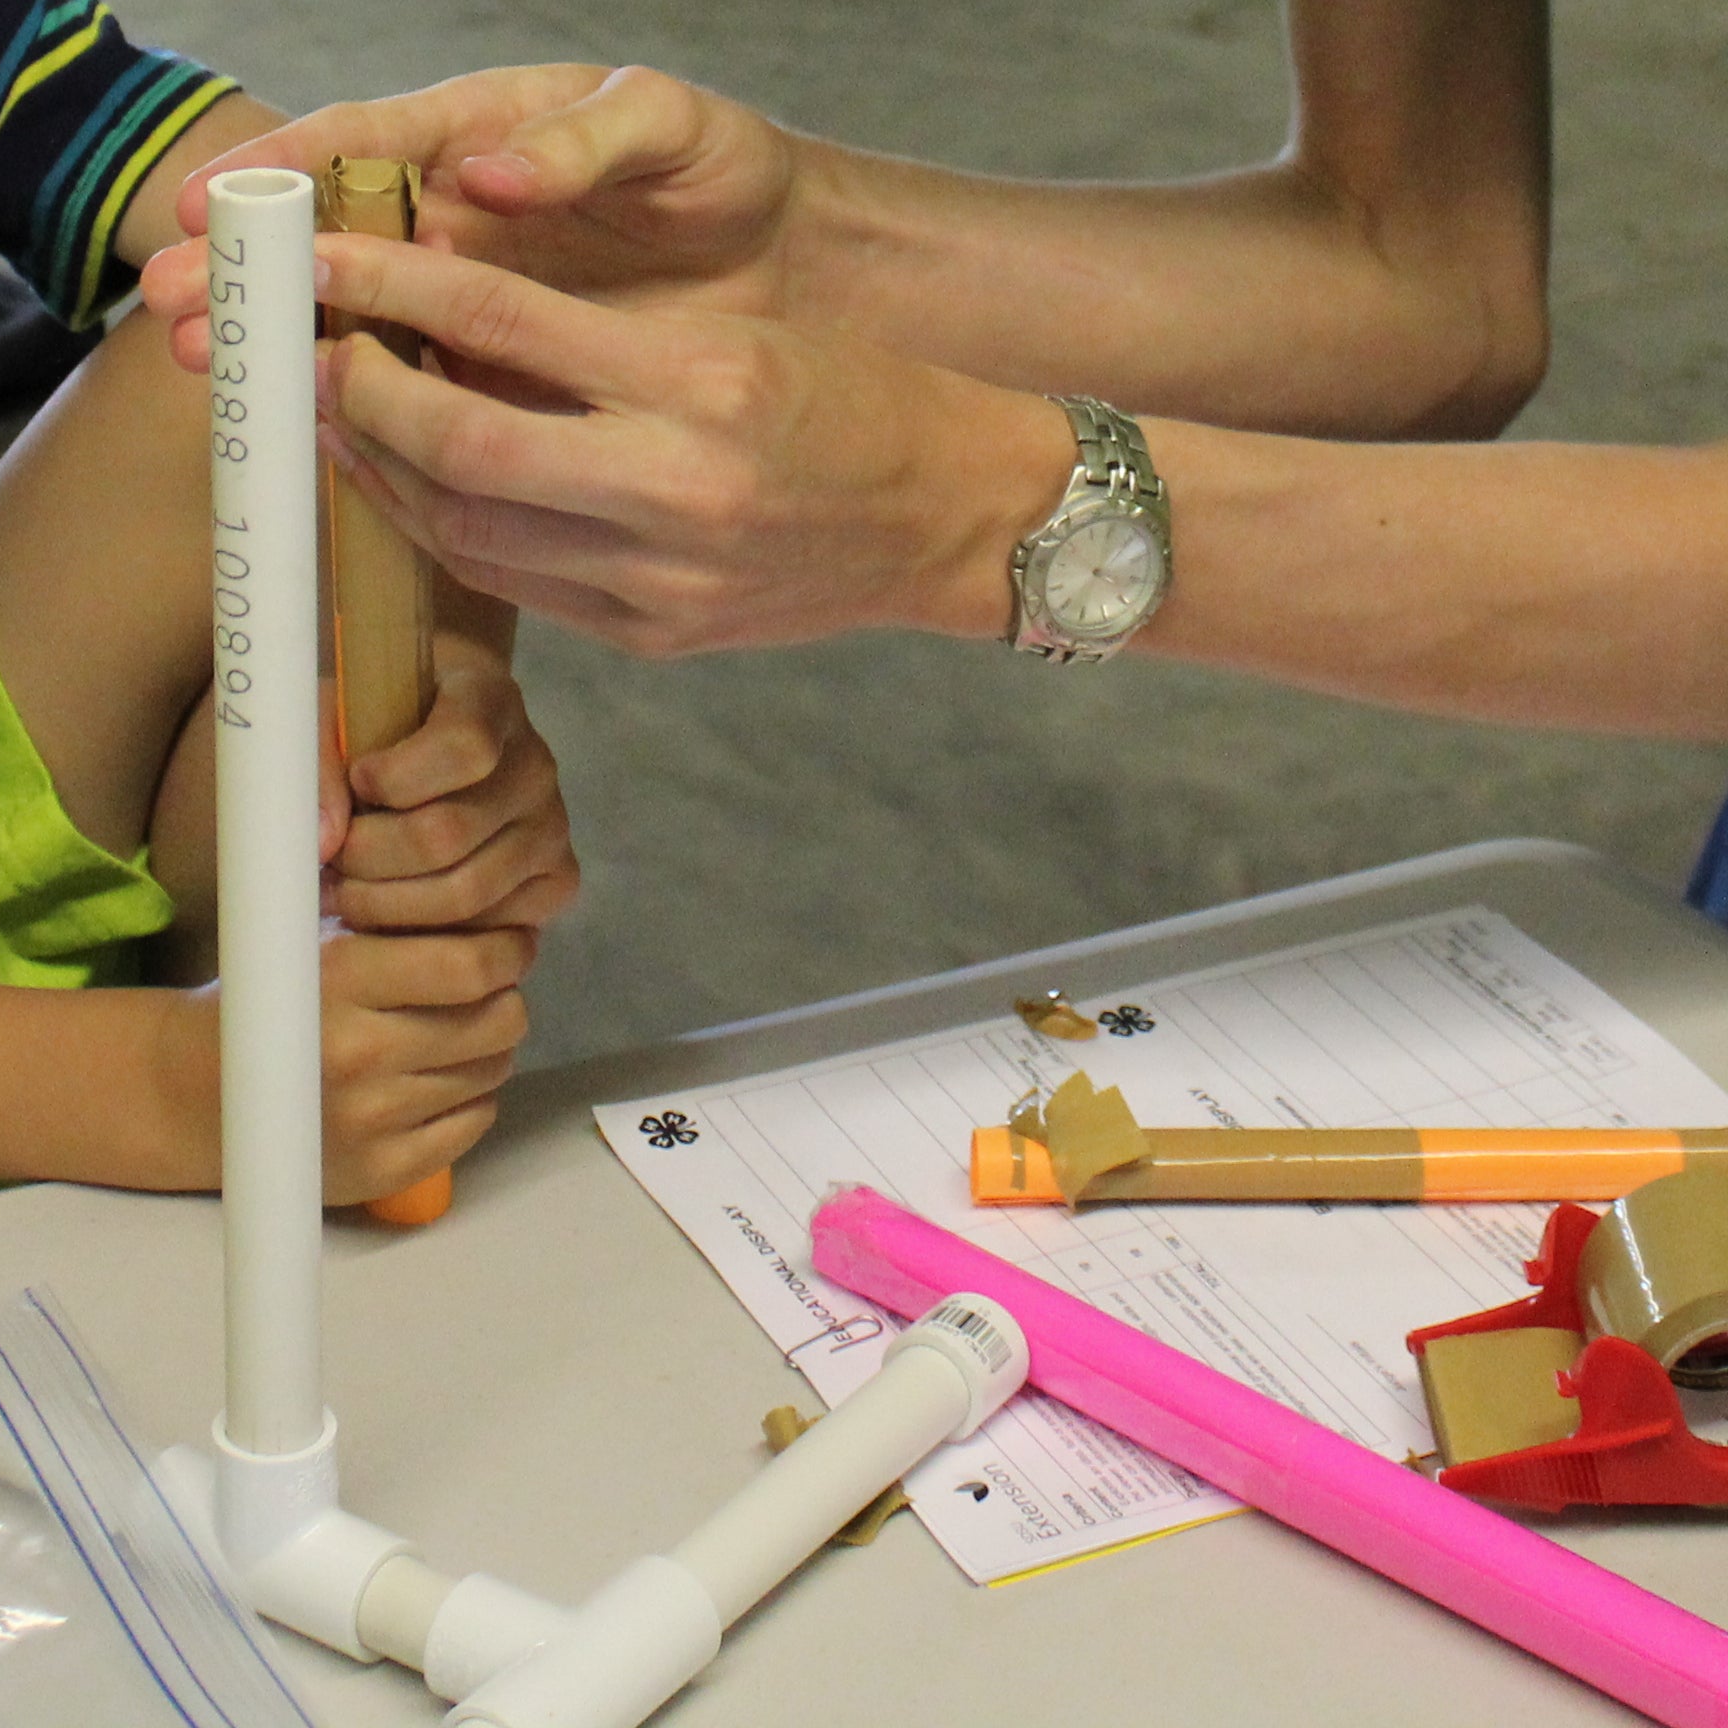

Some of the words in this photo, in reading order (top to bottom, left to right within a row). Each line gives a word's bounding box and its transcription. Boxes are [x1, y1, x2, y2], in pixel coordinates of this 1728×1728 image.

[208, 236, 249, 466] 759388
[213, 507, 253, 731] 100894
[720, 1203, 777, 1256] DISPLAY
[769, 1256, 853, 1343] EDUCATIONAL
[979, 1462, 1062, 1540] Extension
